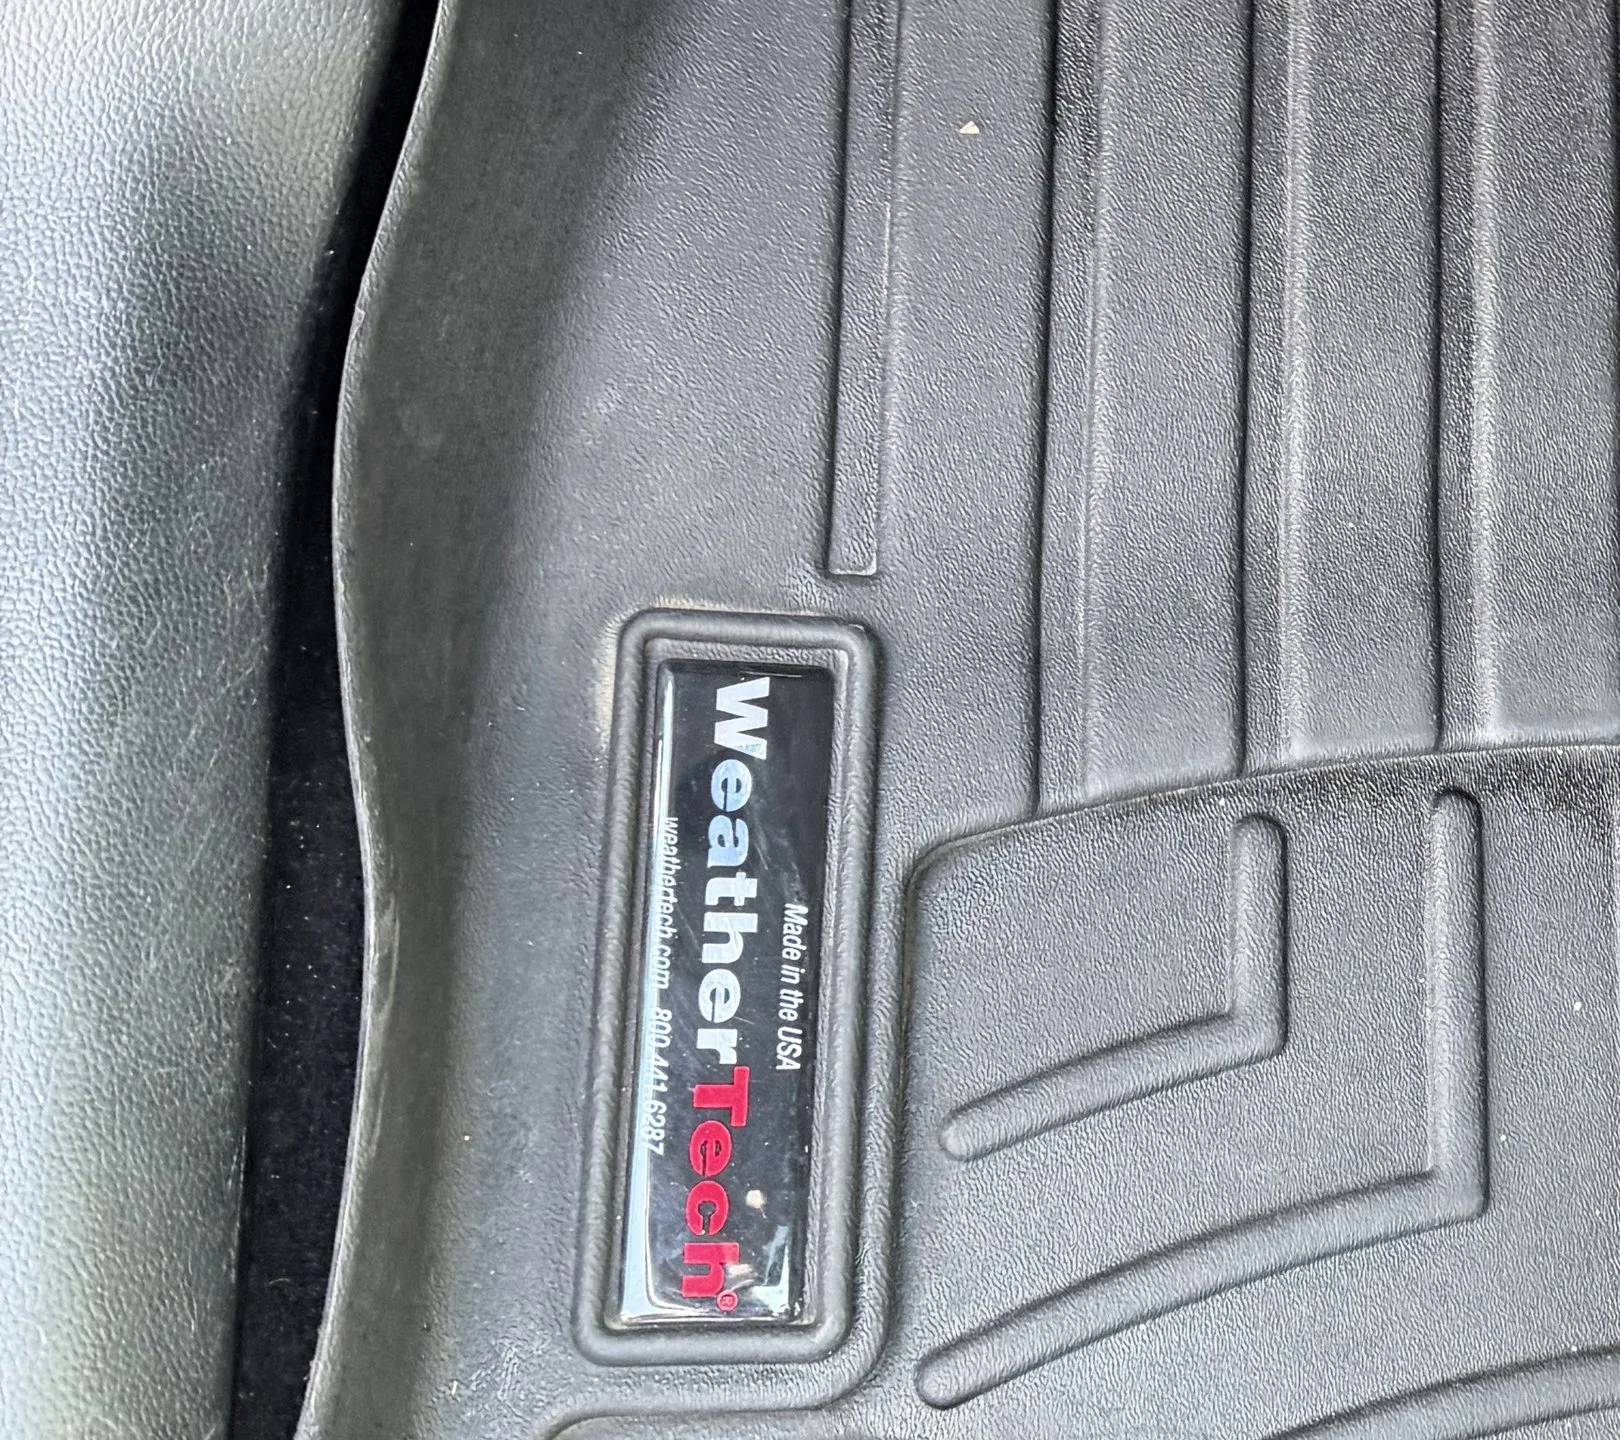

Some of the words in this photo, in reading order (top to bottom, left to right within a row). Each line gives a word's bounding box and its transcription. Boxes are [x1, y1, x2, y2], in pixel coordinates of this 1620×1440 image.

[654, 816, 682, 990] weathertech.com
[780, 902, 808, 961] Made
[780, 963, 806, 987] in
[778, 989, 804, 1021] the
[775, 1026, 803, 1071] USA
[640, 1008, 673, 1156] 800.441.6287
